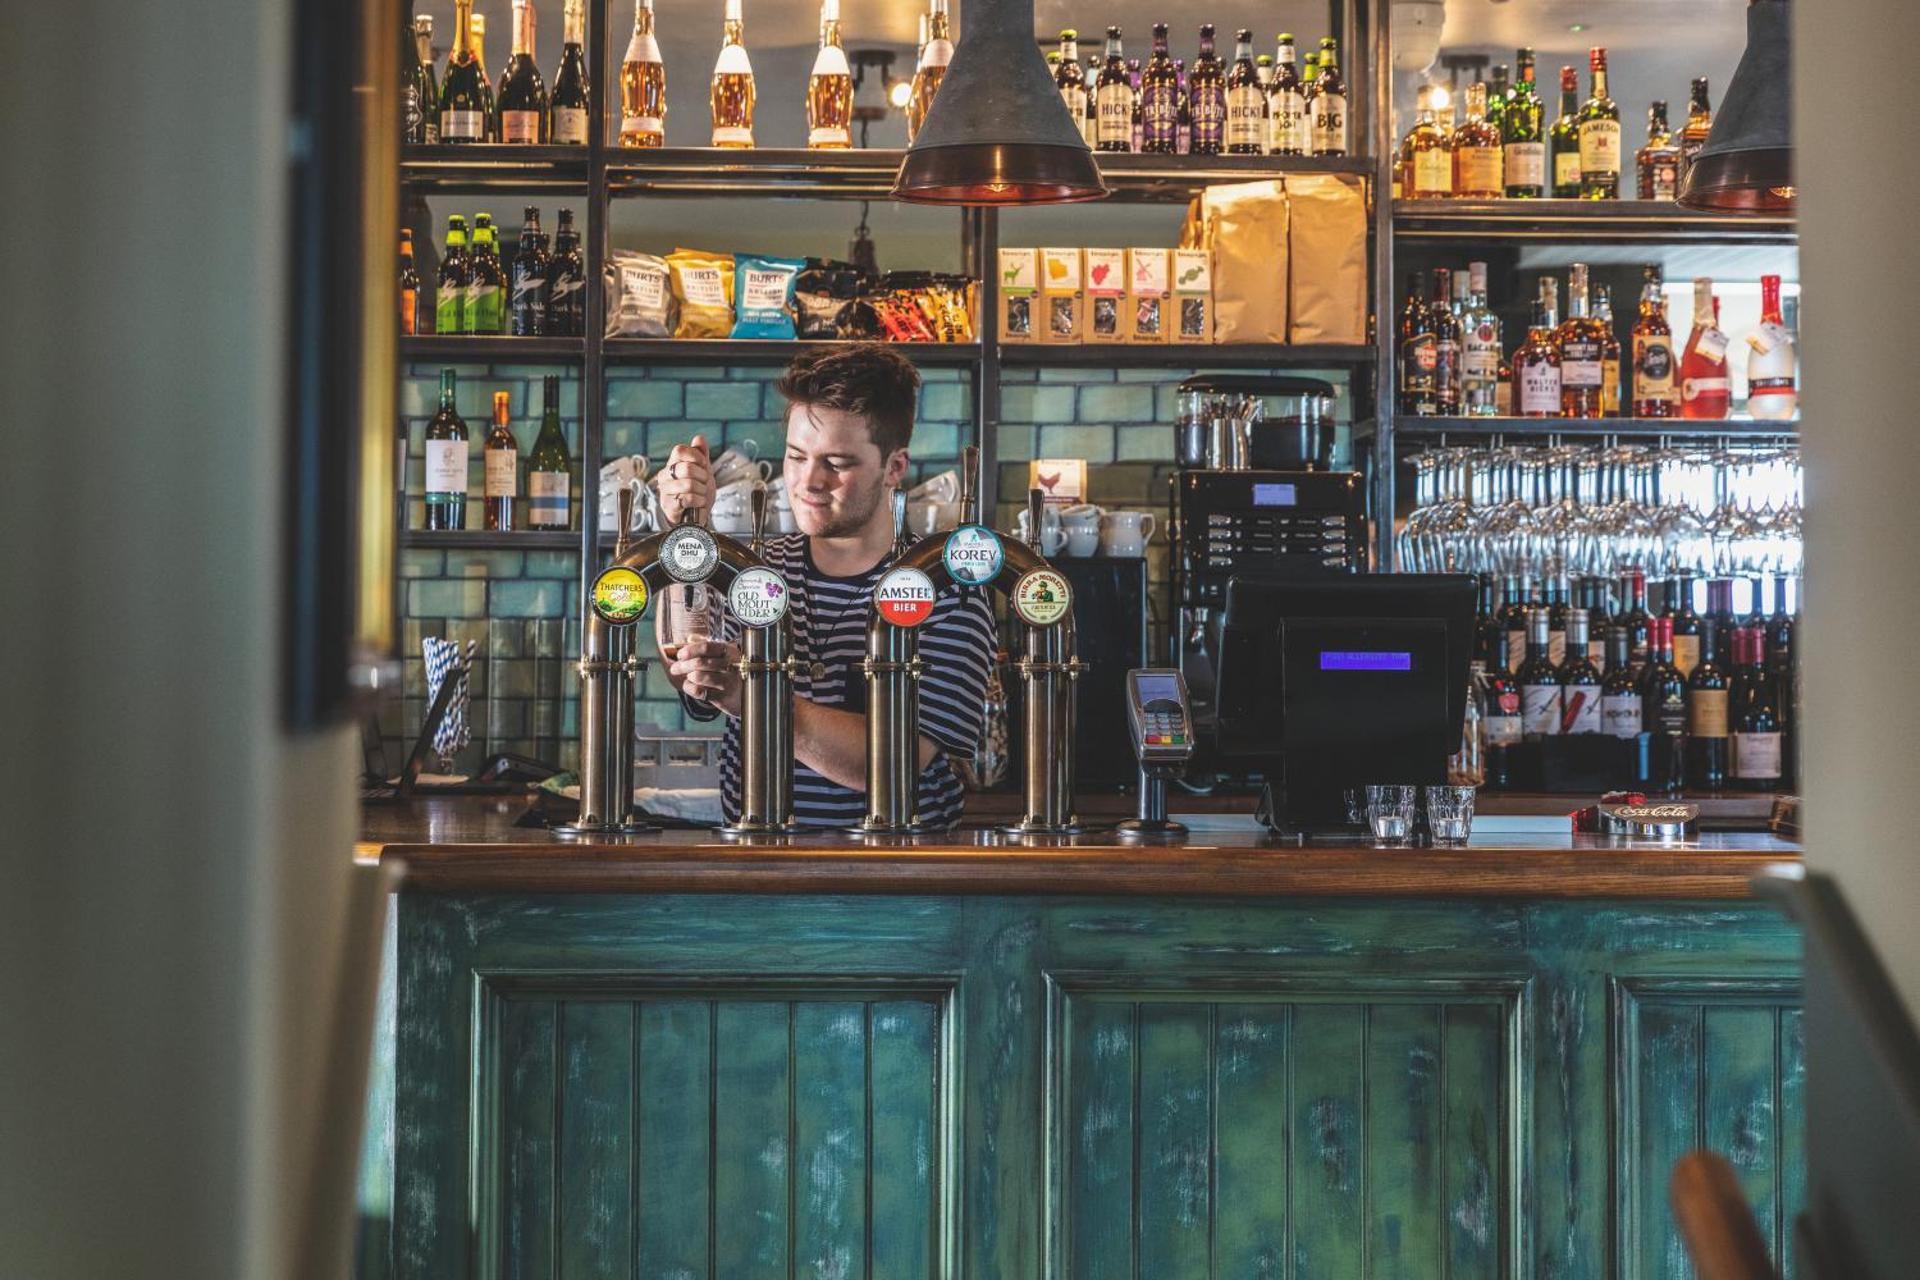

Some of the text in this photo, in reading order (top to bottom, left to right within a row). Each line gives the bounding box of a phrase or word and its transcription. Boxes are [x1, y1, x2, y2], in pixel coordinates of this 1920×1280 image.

[1317, 113, 1343, 128] BIG
[749, 273, 785, 284] BURTS
[950, 549, 997, 560] KOREV
[600, 582, 644, 592] THATCHERS
[1020, 574, 1066, 599] BIRRA MORETTI
[737, 591, 759, 600] OLD
[880, 587, 932, 599] AMSTEL
[738, 599, 772, 608] MOUT
[893, 602, 918, 612] BIER
[736, 607, 770, 617] CIDER
[1614, 805, 1688, 817] Coca-Cola
